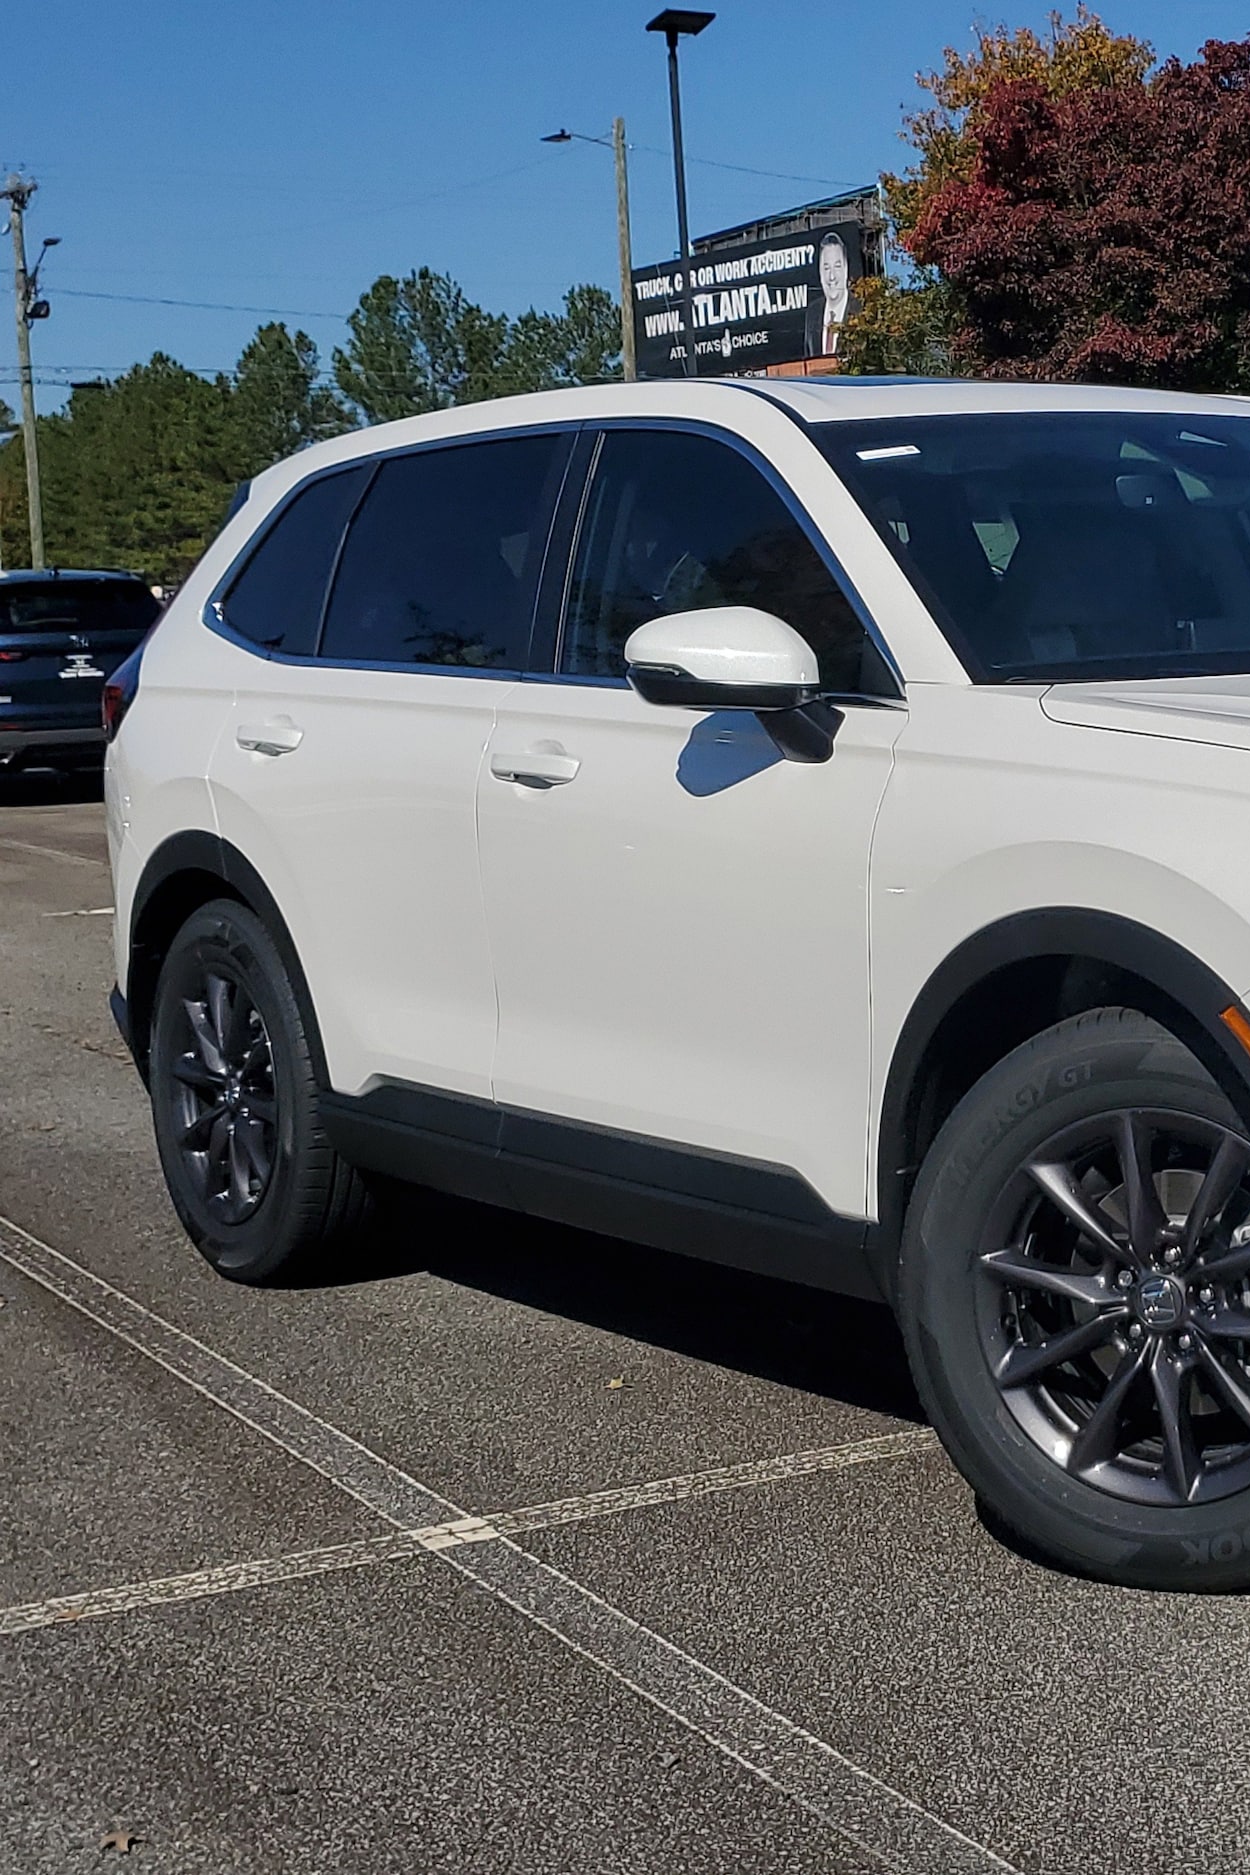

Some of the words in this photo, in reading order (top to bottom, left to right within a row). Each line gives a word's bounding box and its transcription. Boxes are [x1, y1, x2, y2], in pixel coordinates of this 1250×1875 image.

[635, 275, 674, 300] TRUCK,
[674, 270, 697, 292] CR
[698, 266, 714, 287] OR
[714, 259, 749, 282] WORK
[750, 244, 815, 274] ACCIDENT?
[670, 338, 722, 360] ATLNTA'S
[732, 330, 769, 349] CHOICE
[1058, 1058, 1099, 1088] GT
